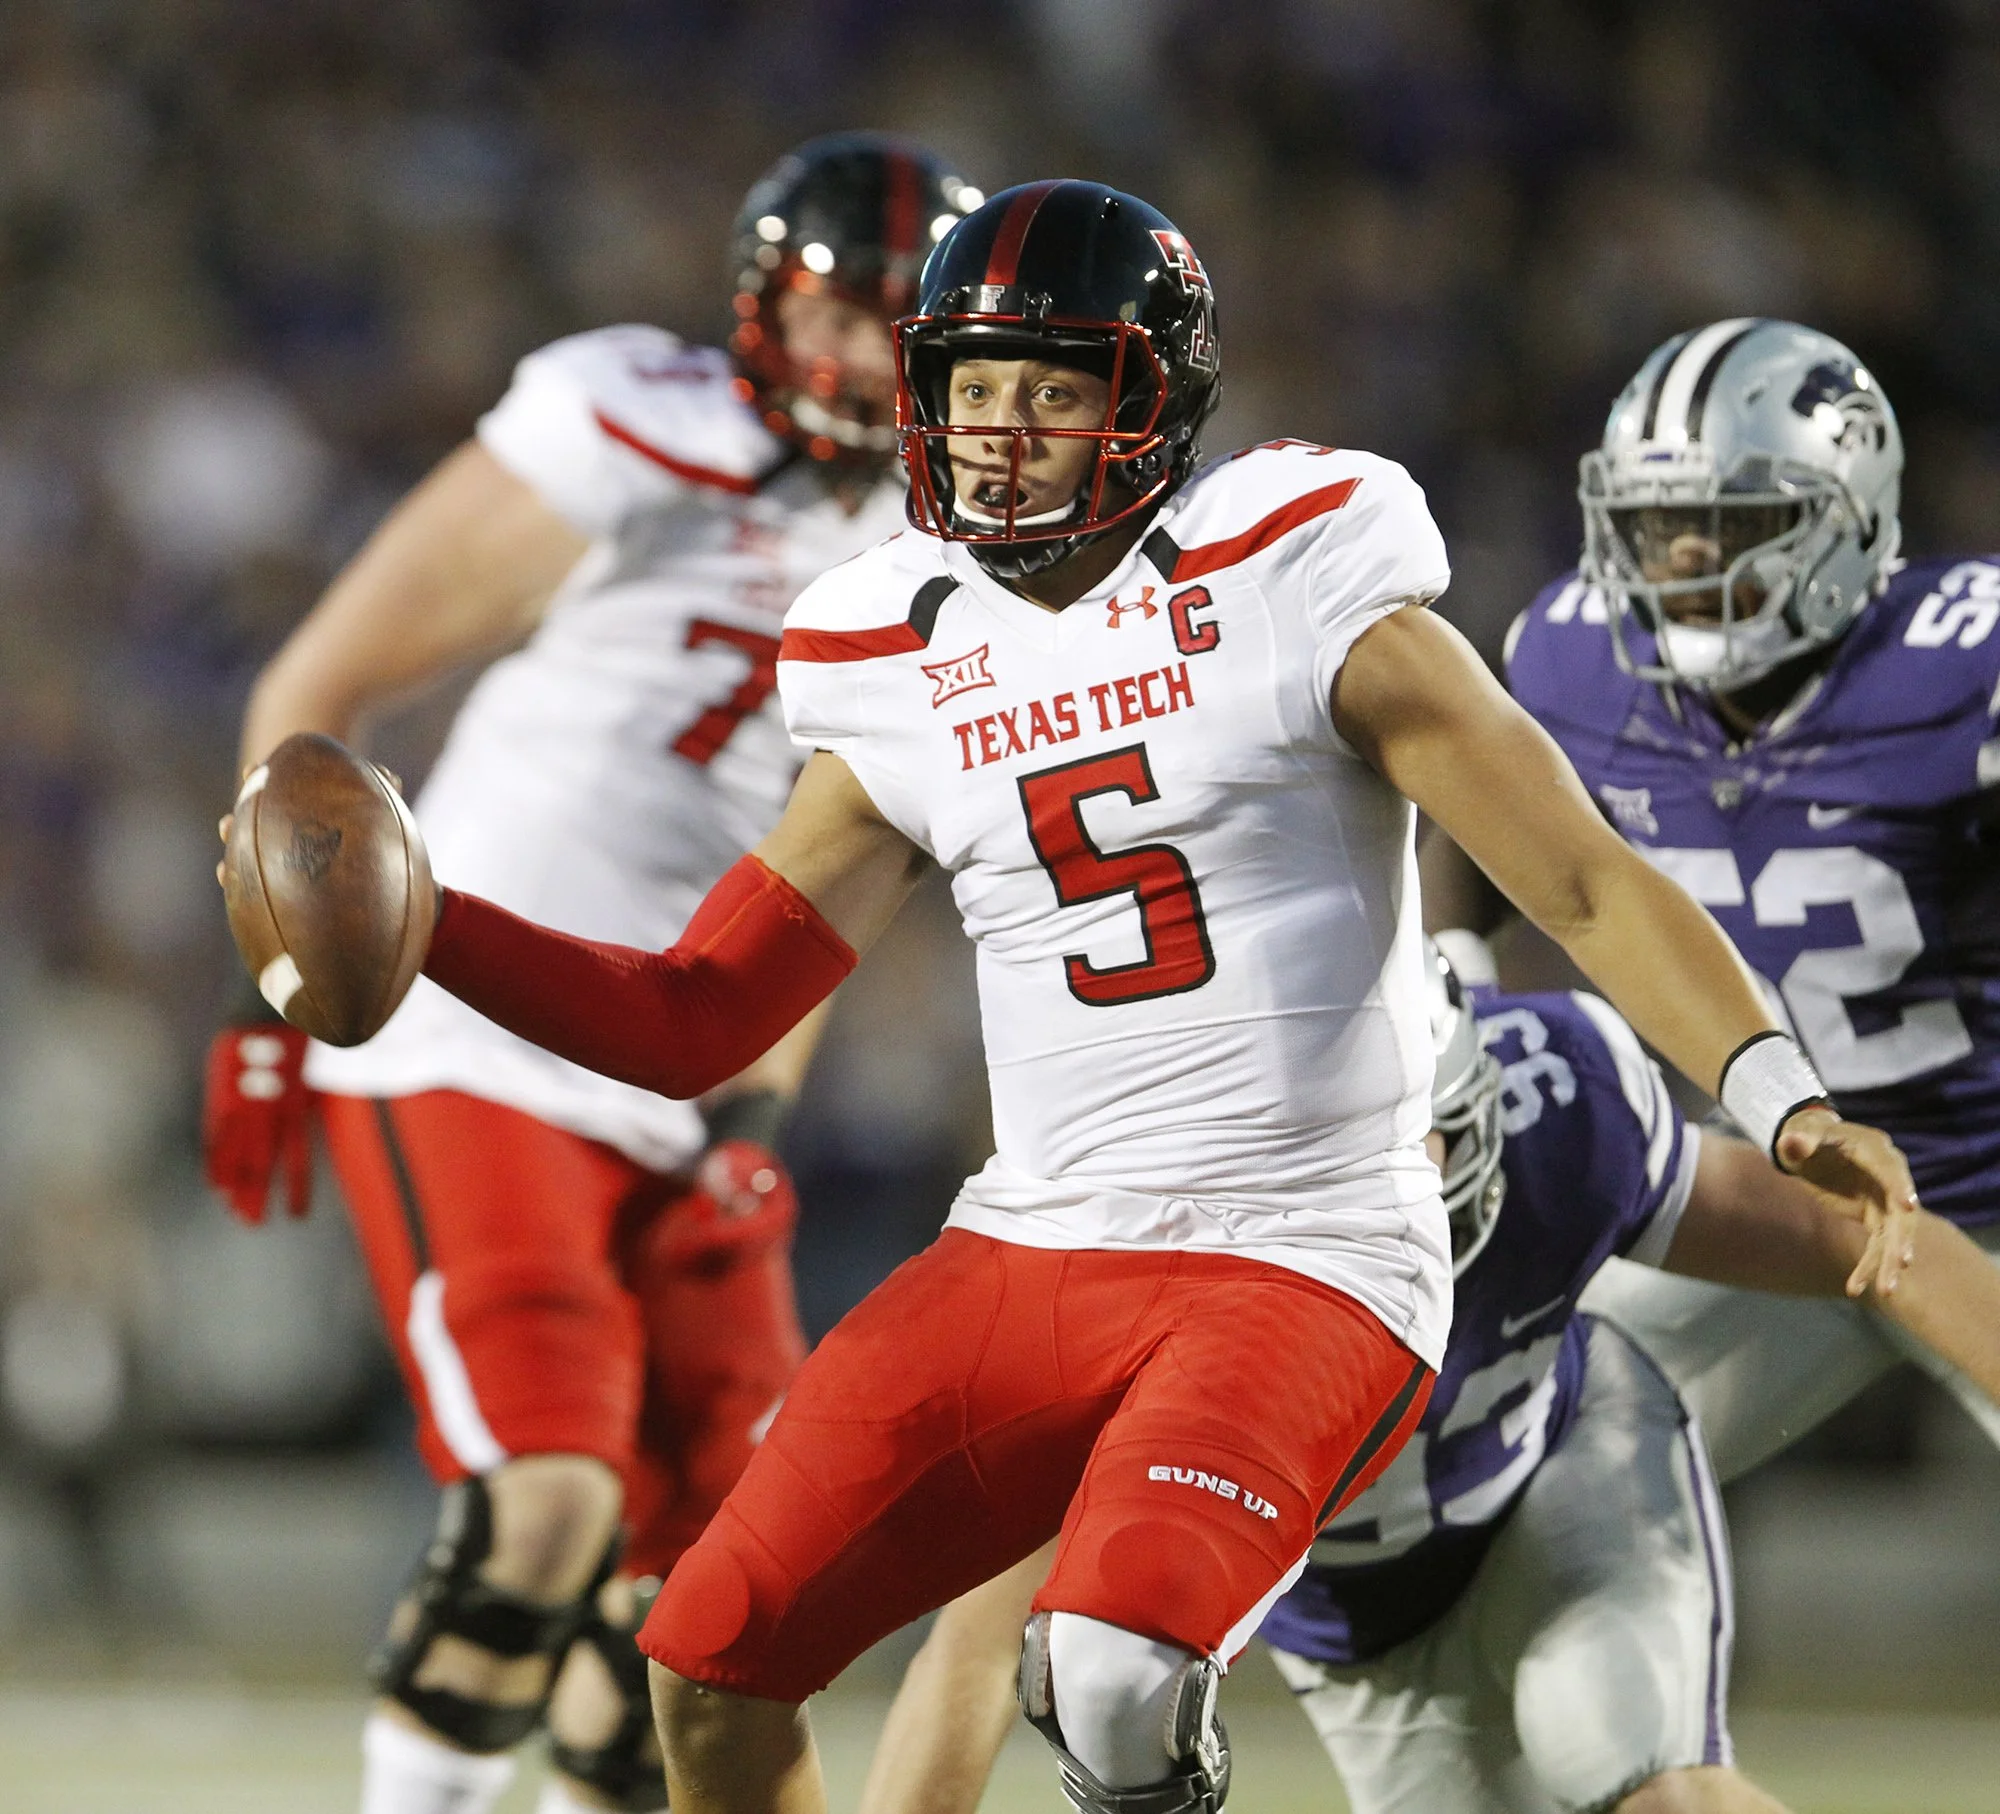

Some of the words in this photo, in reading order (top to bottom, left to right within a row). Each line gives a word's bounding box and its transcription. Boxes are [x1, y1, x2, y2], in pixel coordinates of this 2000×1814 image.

[1169, 584, 1221, 656] C
[952, 693, 1080, 771] TEXAS
[1089, 662, 1195, 732] TECH
[1017, 741, 1216, 1008] 5
[1148, 1465, 1239, 1500] GUNS
[1243, 1489, 1279, 1519] UP
